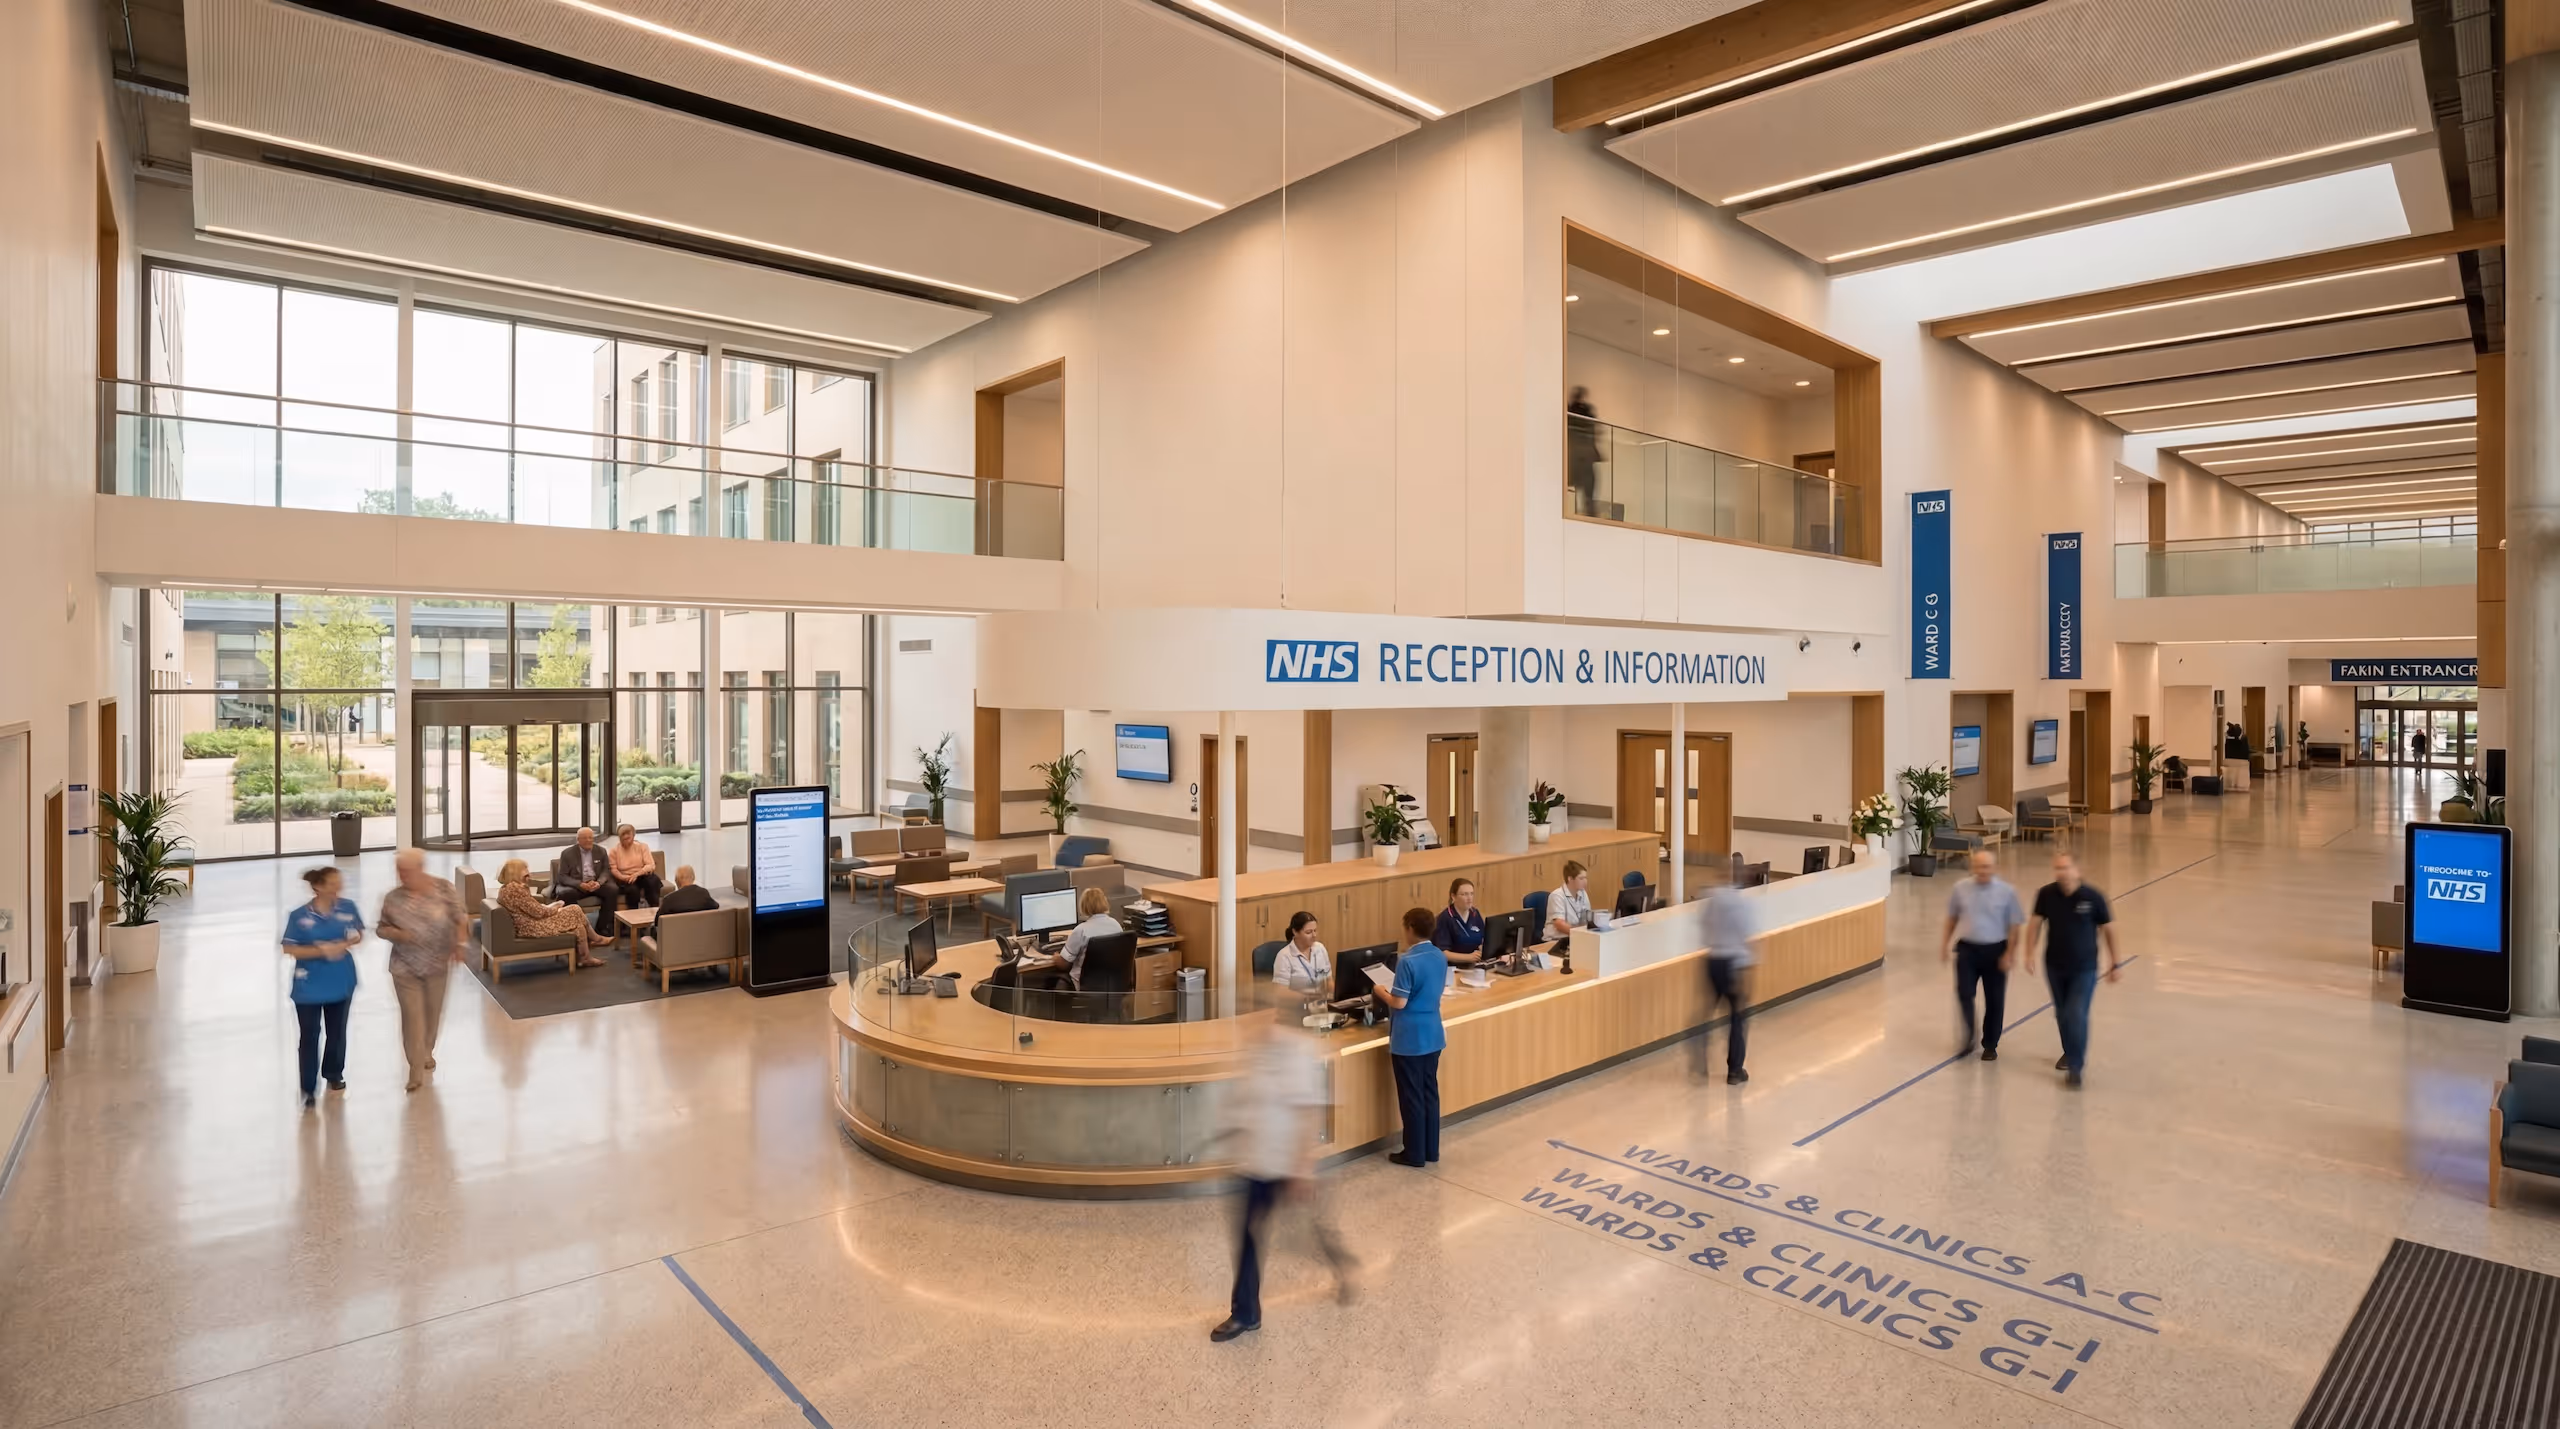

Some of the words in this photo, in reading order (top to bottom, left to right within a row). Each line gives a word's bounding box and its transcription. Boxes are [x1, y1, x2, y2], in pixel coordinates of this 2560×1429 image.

[1269, 642, 1357, 680] NHS
[1379, 643, 1565, 684] RECEPTION
[1575, 649, 1594, 684] &
[1604, 650, 1766, 684] INFORMATION
[1925, 624, 1939, 671] WARD
[2429, 881, 2483, 901] NHS
[1621, 1144, 1781, 1199] WARDS
[1784, 1195, 1820, 1214] &
[1834, 1209, 2031, 1276] CLINICS
[2041, 1272, 2163, 1317] A-C
[1551, 1167, 1715, 1229] WARDS
[1718, 1226, 1757, 1249] &
[1770, 1243, 1984, 1323] CLINICS
[2002, 1318, 2101, 1363] G-I
[1520, 1186, 1686, 1252] WARDS
[1687, 1247, 1729, 1271] &
[1742, 1265, 1962, 1351] CLINICS
[1979, 1346, 2078, 1394] G-I
